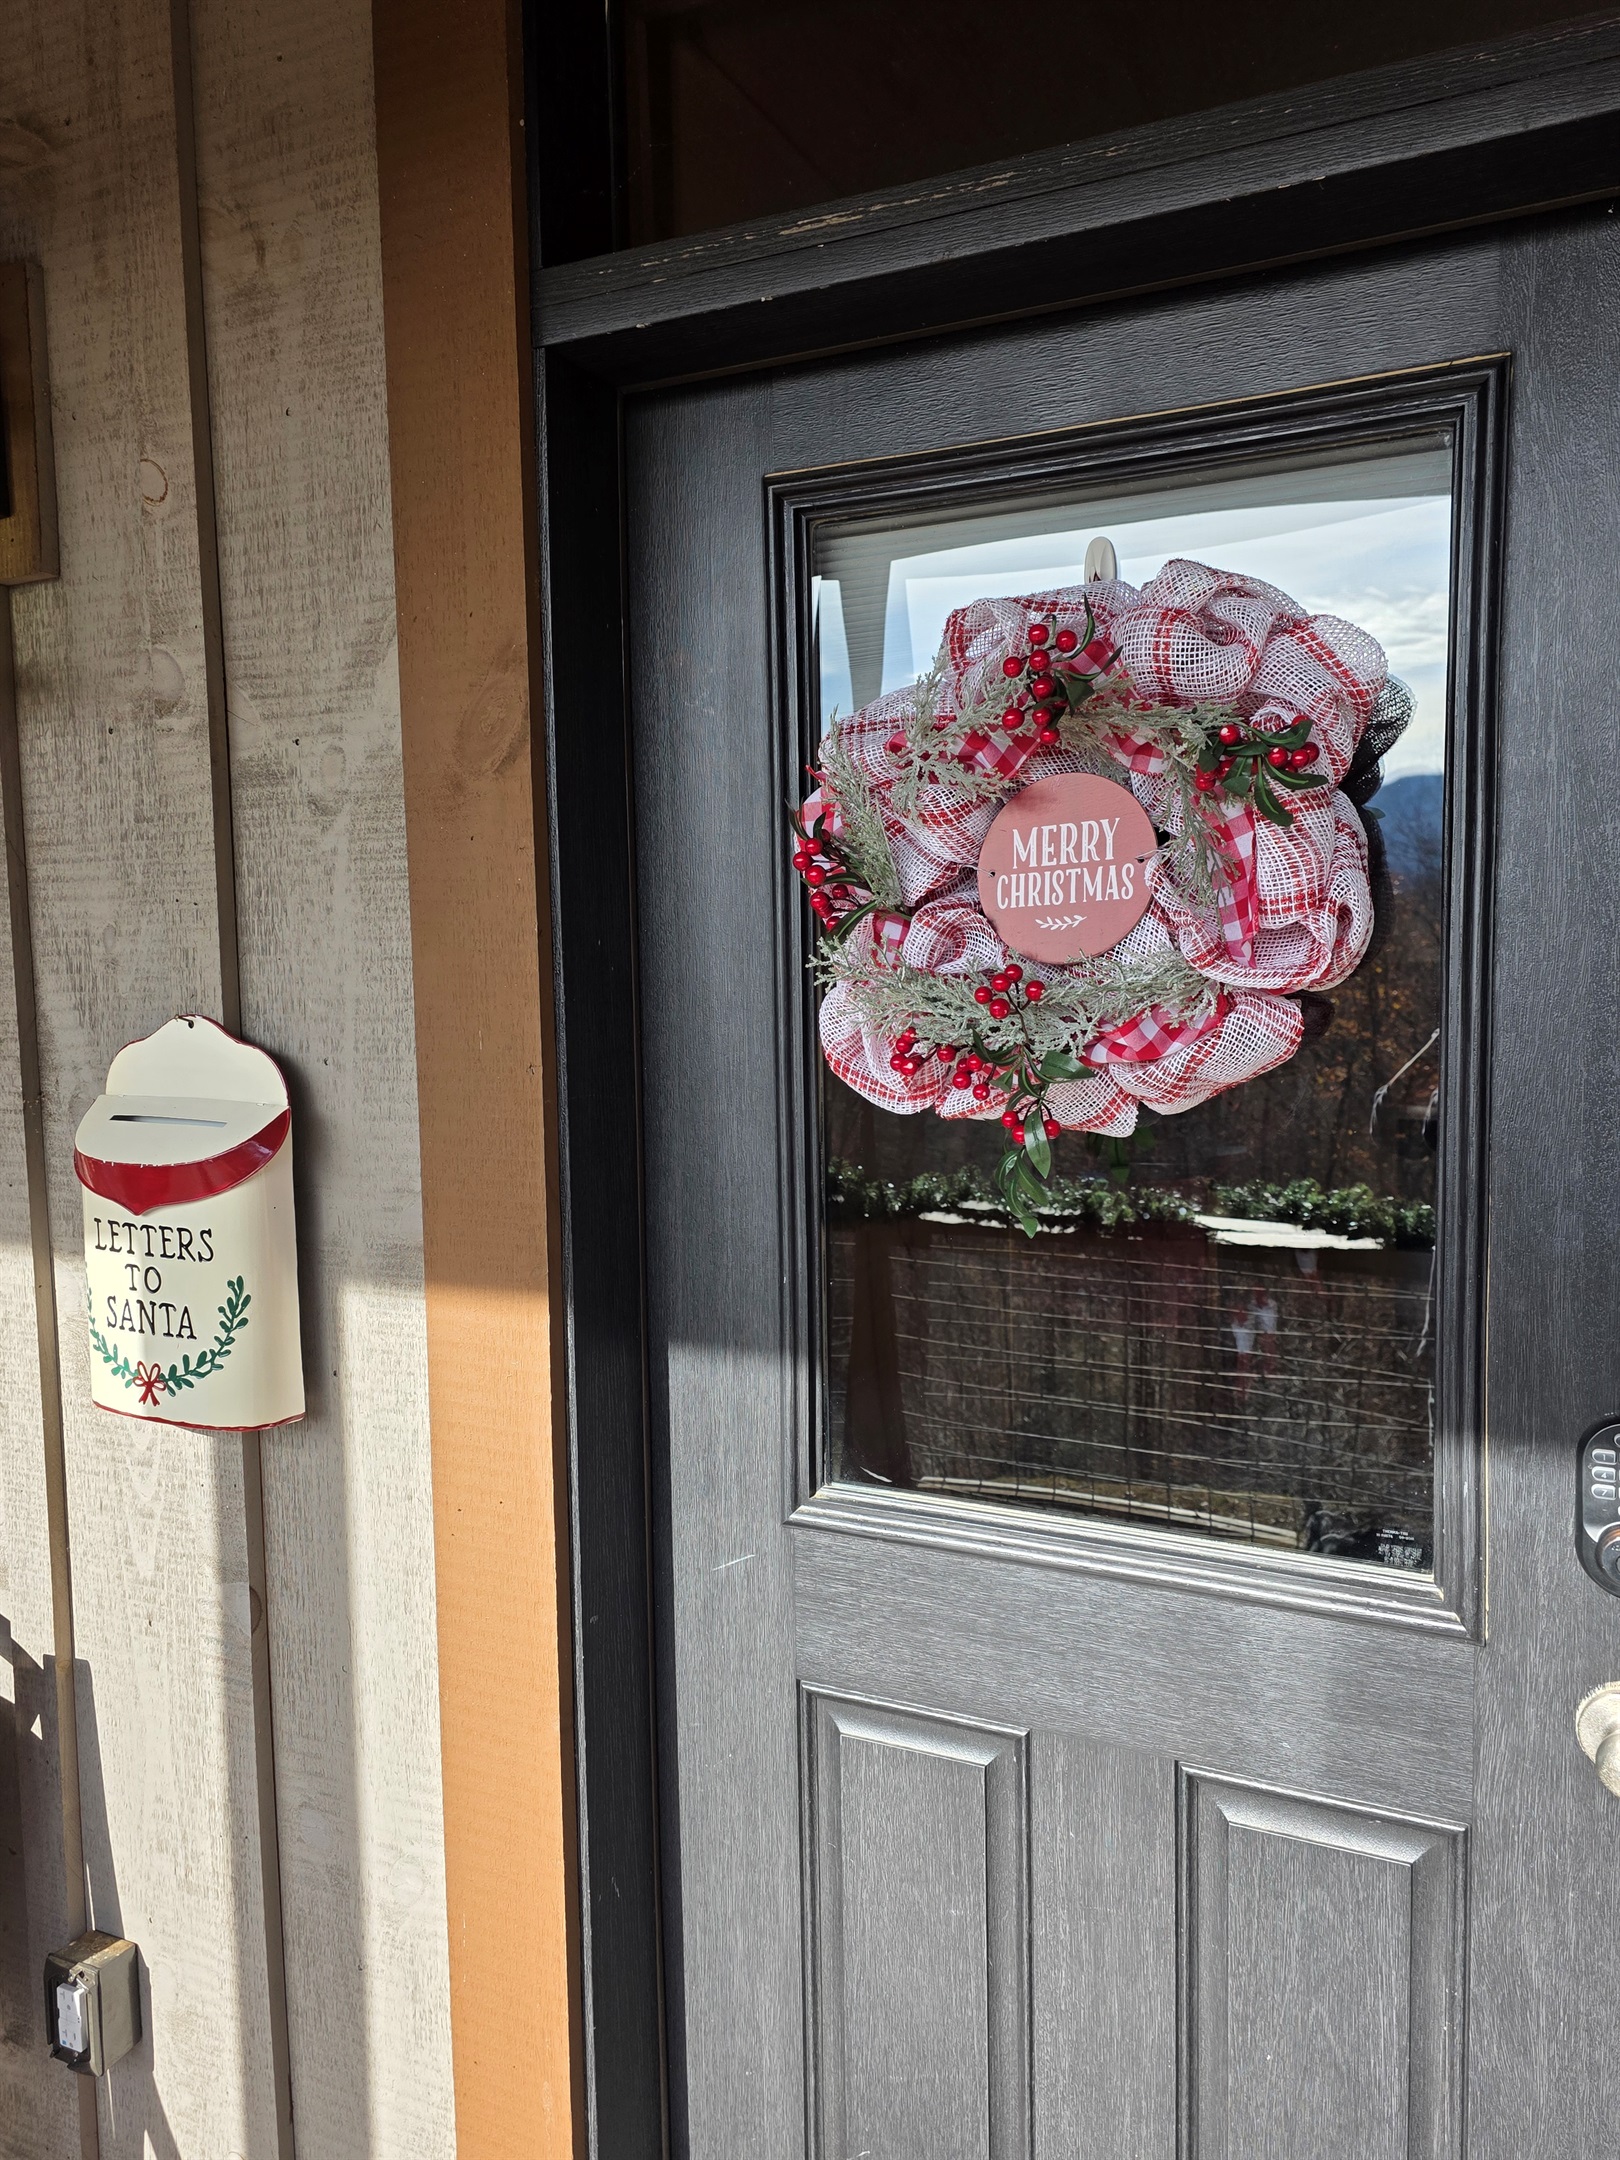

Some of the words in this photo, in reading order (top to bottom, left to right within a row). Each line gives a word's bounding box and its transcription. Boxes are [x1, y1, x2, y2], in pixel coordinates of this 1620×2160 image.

[1012, 817, 1121, 870] MERRY
[996, 862, 1135, 910] CHRISTMAS
[93, 1217, 215, 1263] LETTERS
[124, 1263, 162, 1294] TO
[106, 1295, 198, 1340] SANTA
